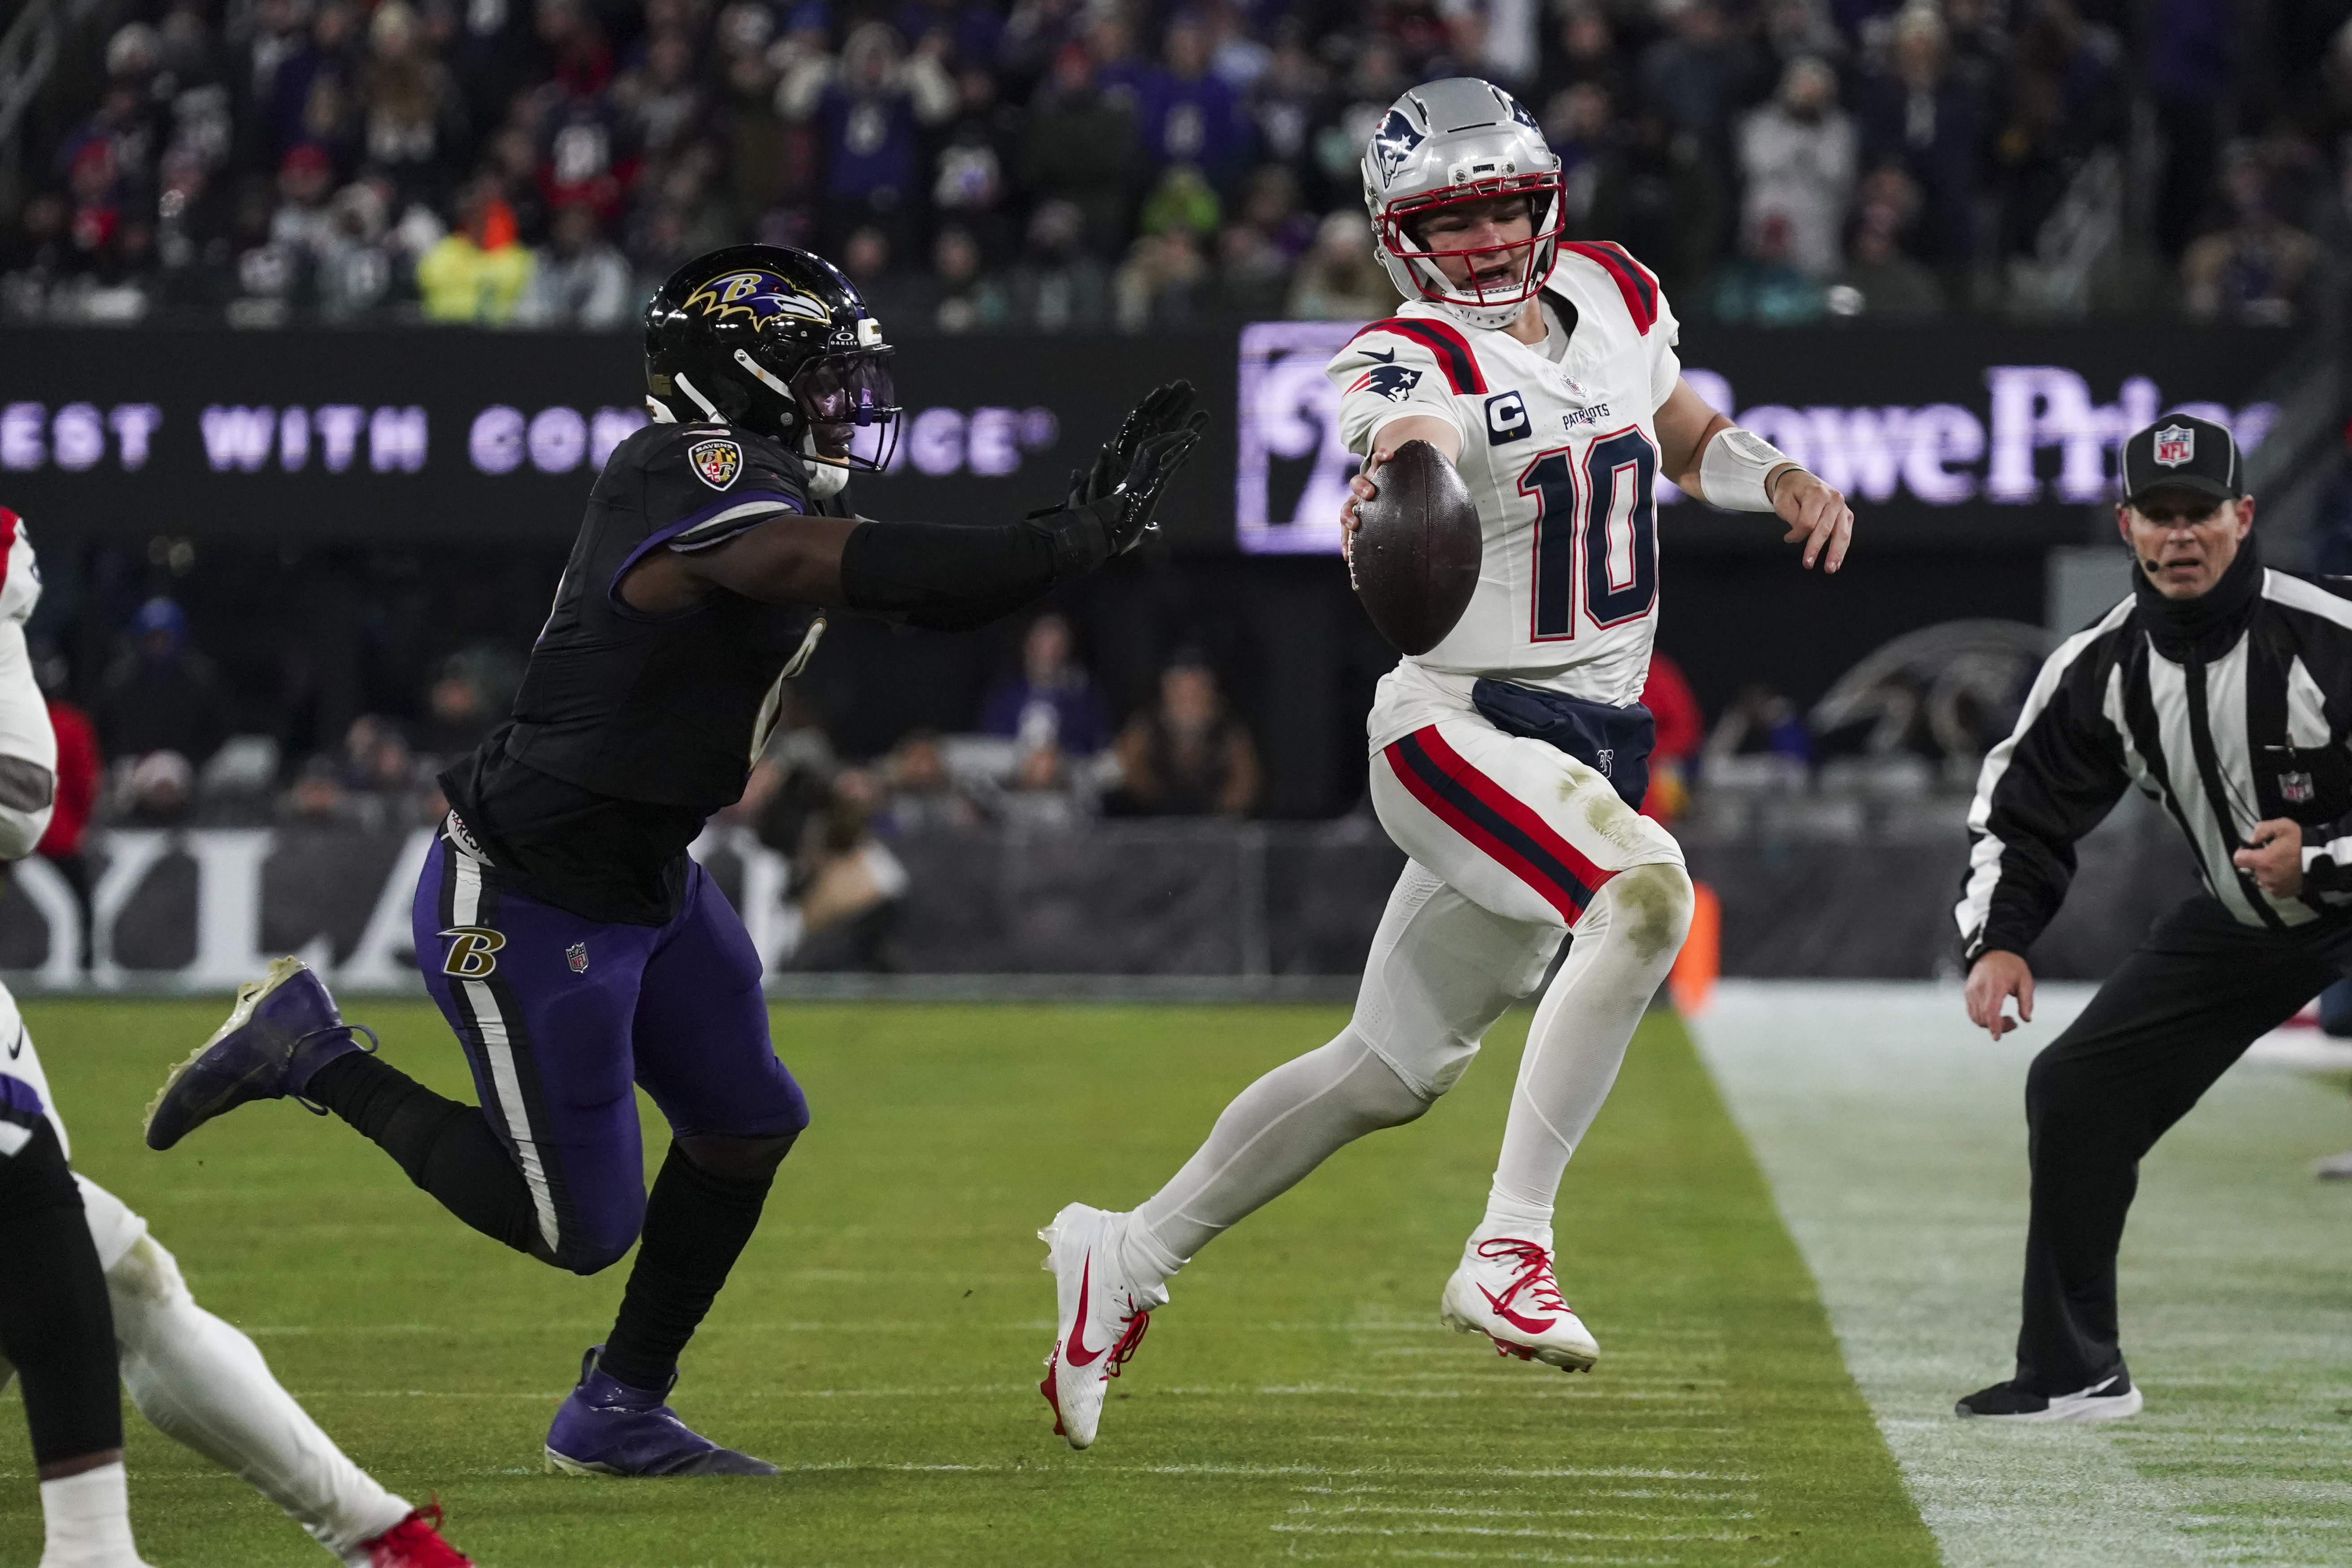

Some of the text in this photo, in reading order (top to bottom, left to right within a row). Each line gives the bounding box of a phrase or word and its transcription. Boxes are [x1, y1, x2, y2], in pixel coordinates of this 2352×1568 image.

[713, 273, 763, 303] B
[1488, 395, 1526, 432] C
[1562, 403, 1610, 430] PATRIOTS
[199, 402, 429, 474] WITH
[695, 443, 733, 452] RAVENS
[2159, 442, 2190, 459] NFL
[1517, 424, 1658, 642] 10
[436, 926, 506, 978] B
[572, 955, 586, 968] NFL
